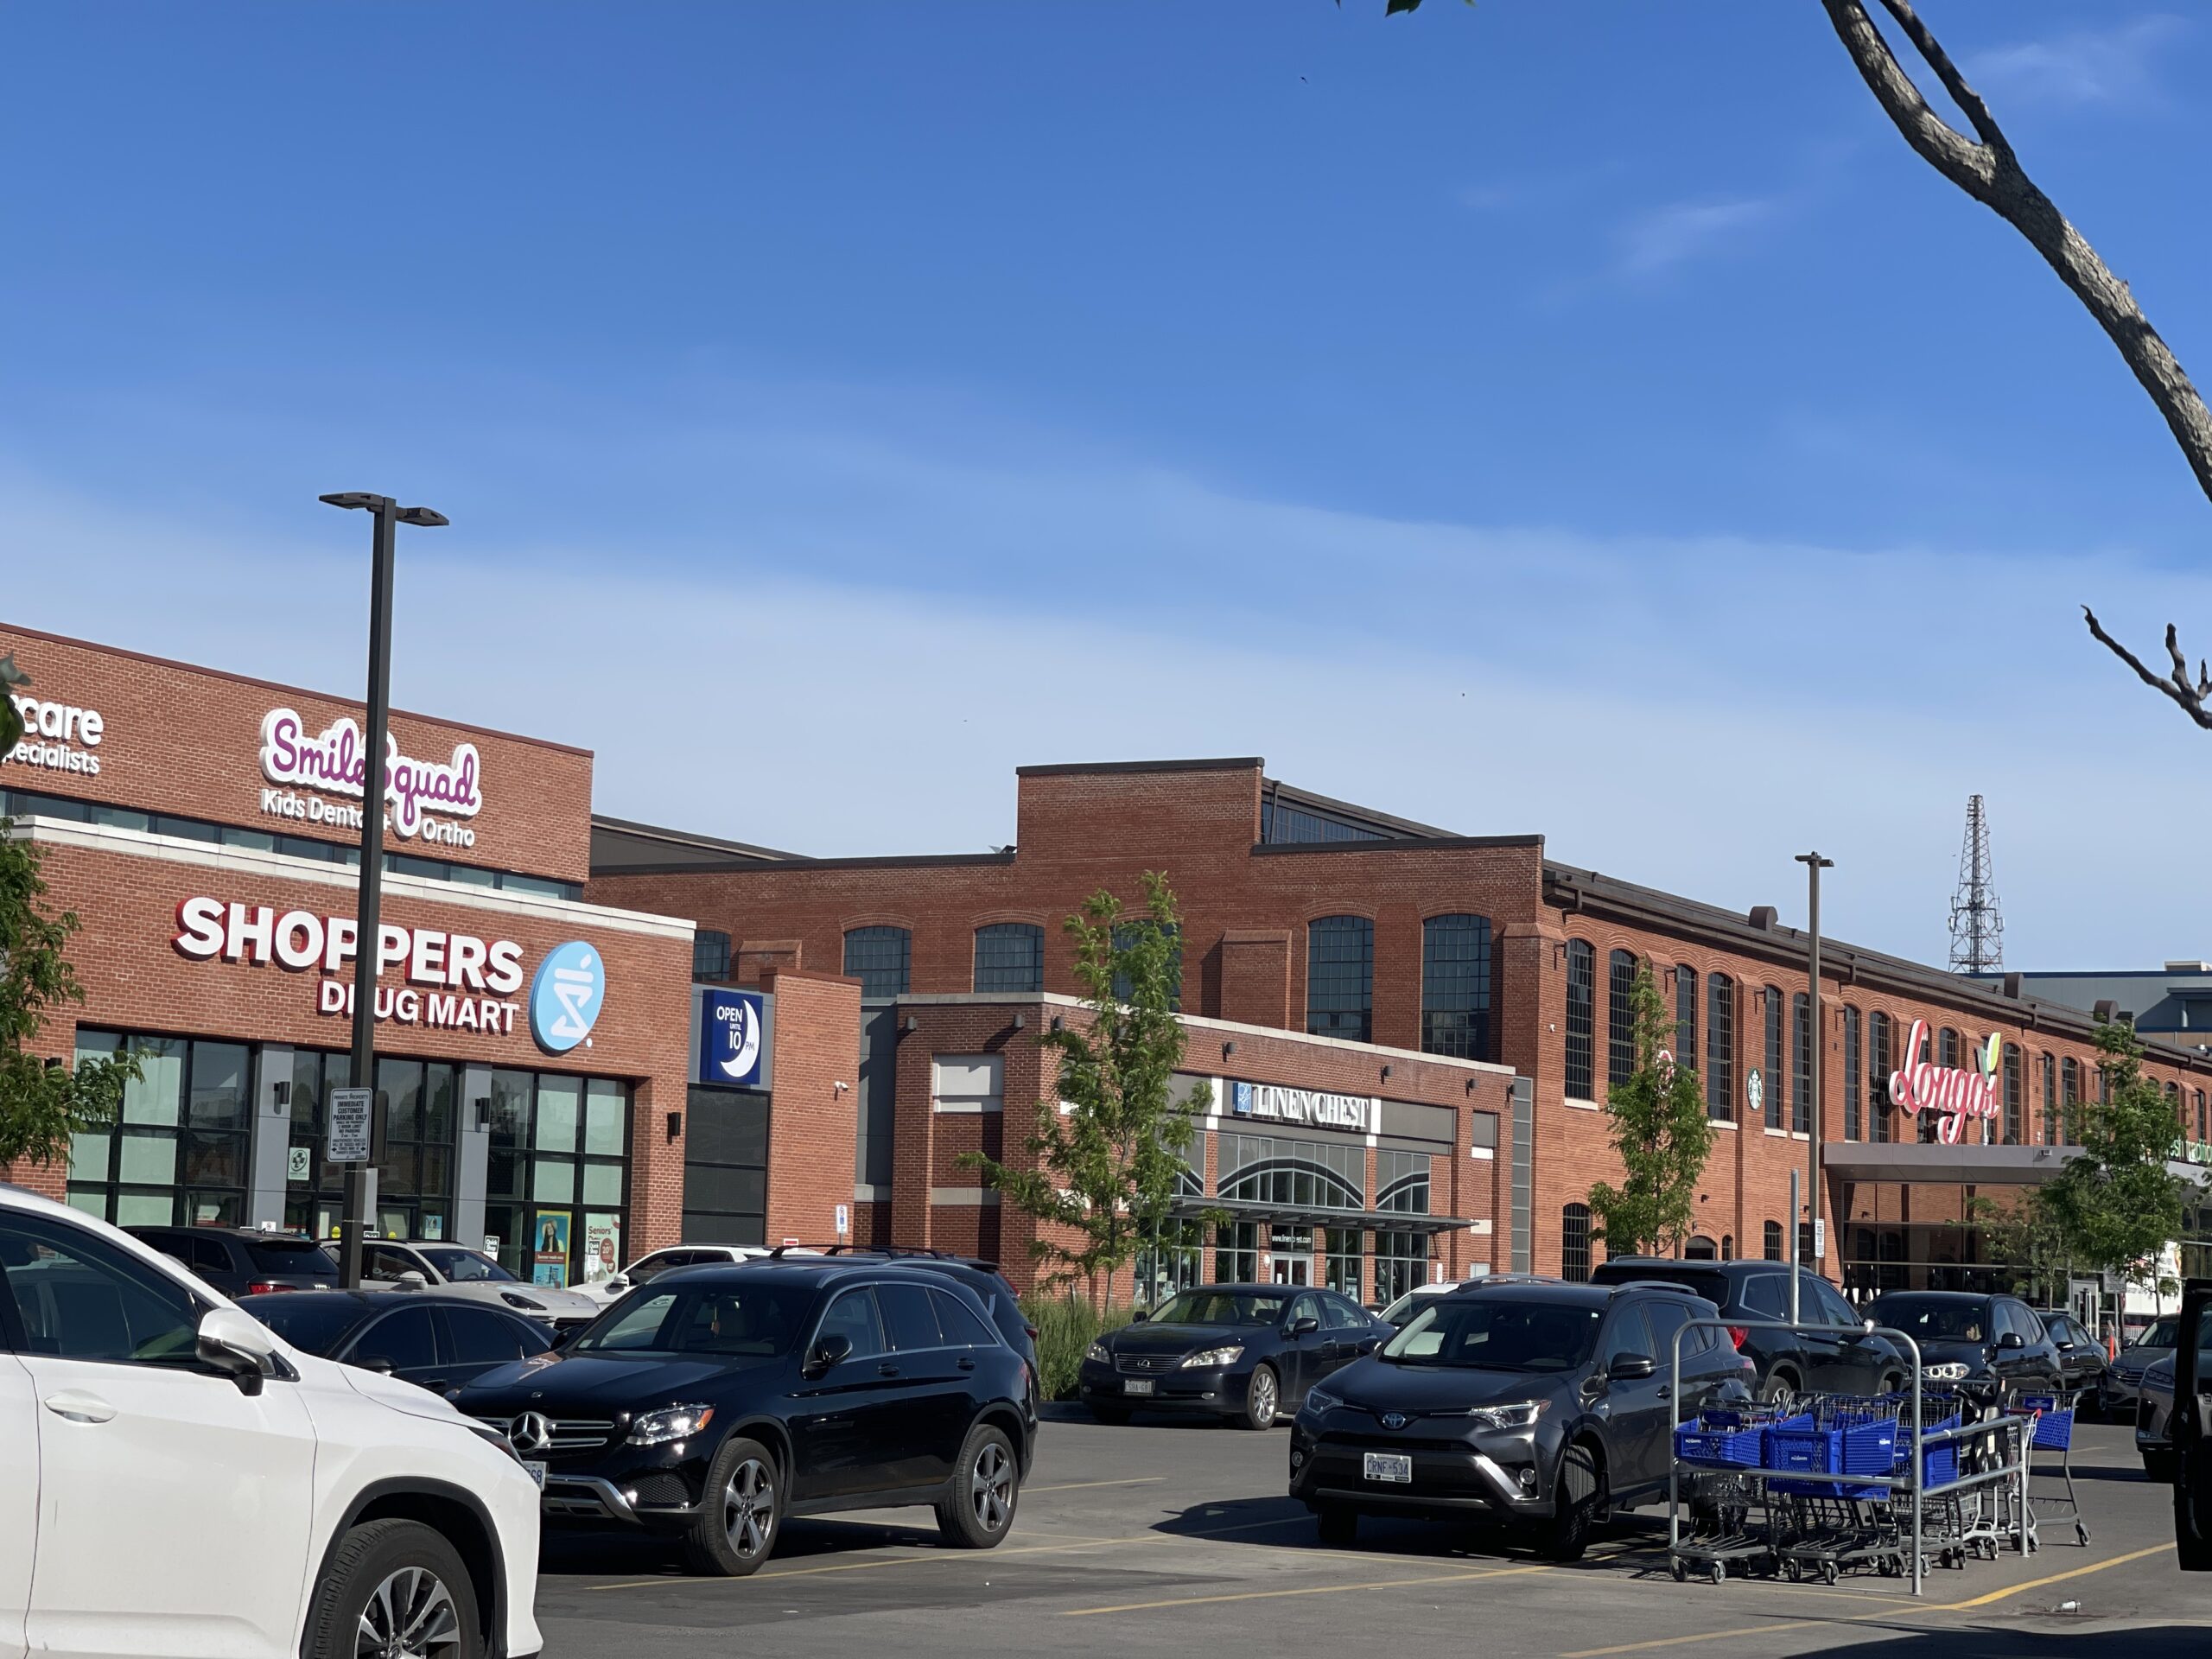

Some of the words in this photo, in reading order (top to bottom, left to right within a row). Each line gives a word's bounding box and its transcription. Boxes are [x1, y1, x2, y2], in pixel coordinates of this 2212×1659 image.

[10, 694, 104, 746] care
[261, 788, 305, 818] Kids
[422, 817, 476, 848] Ortho
[172, 896, 524, 995] SHOPPERS
[427, 994, 520, 1033] MART
[716, 1005, 743, 1022] OPEN
[729, 1030, 741, 1050] 10
[745, 1041, 755, 1051] PM
[1252, 1084, 1312, 1121] LINEN
[1311, 1092, 1370, 1127] CHEST
